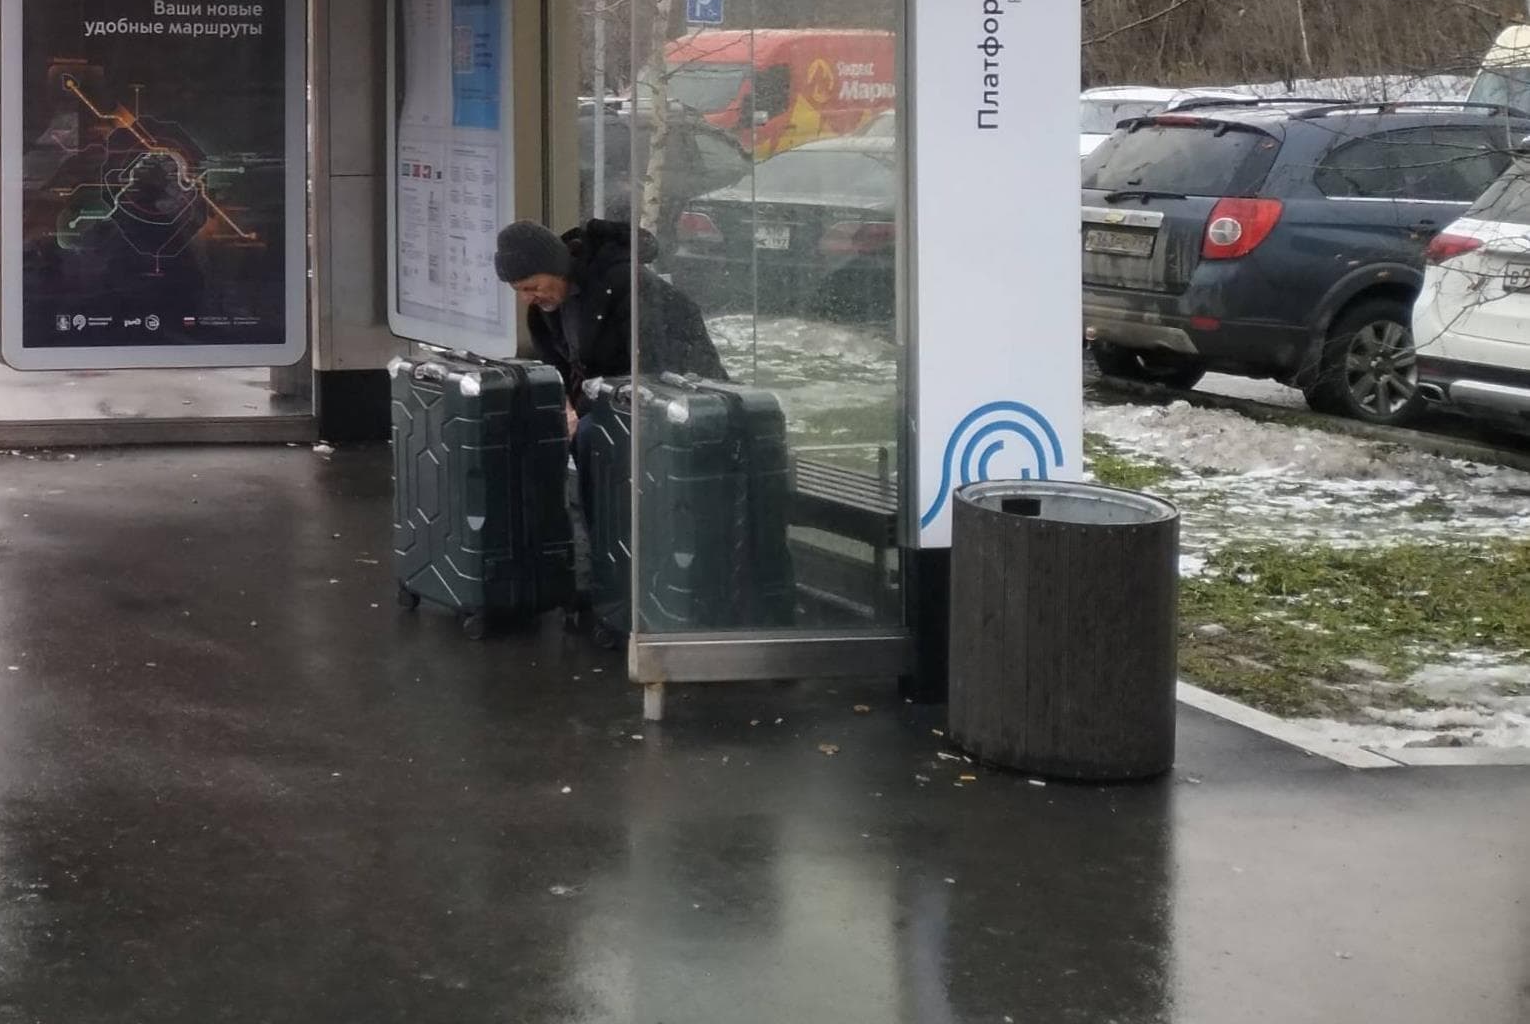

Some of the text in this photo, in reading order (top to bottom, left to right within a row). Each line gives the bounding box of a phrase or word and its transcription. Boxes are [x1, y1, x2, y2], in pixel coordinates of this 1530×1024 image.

[153, 0, 263, 16] Ваши новые
[84, 18, 263, 38] удобные маршруты
